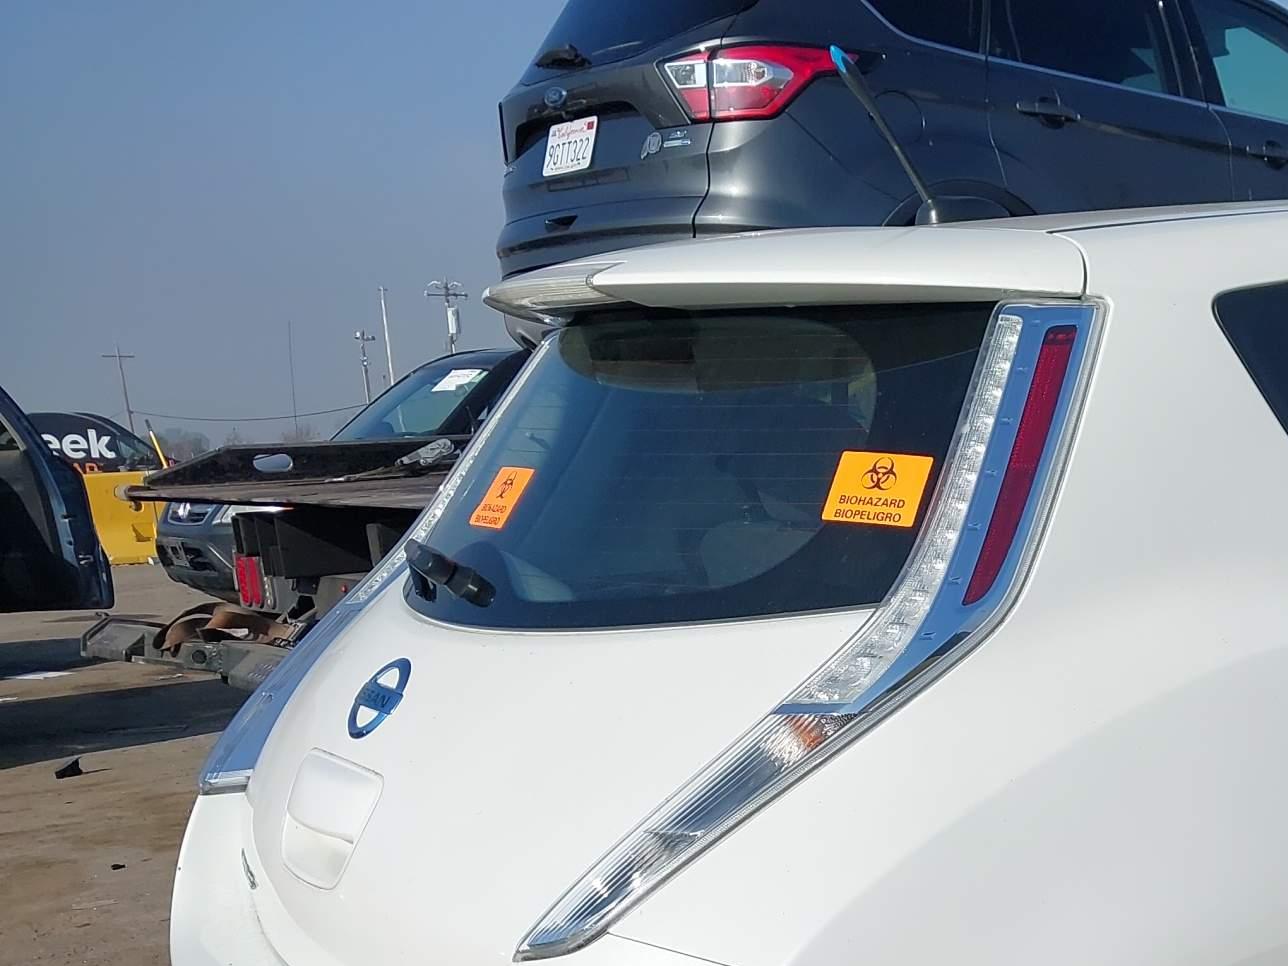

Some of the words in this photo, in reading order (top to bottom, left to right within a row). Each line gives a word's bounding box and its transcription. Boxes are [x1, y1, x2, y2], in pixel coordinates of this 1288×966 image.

[547, 137, 590, 168] 9GTT322
[839, 494, 905, 509] BIOHAZARD
[834, 508, 902, 523] BIOPELIGRO
